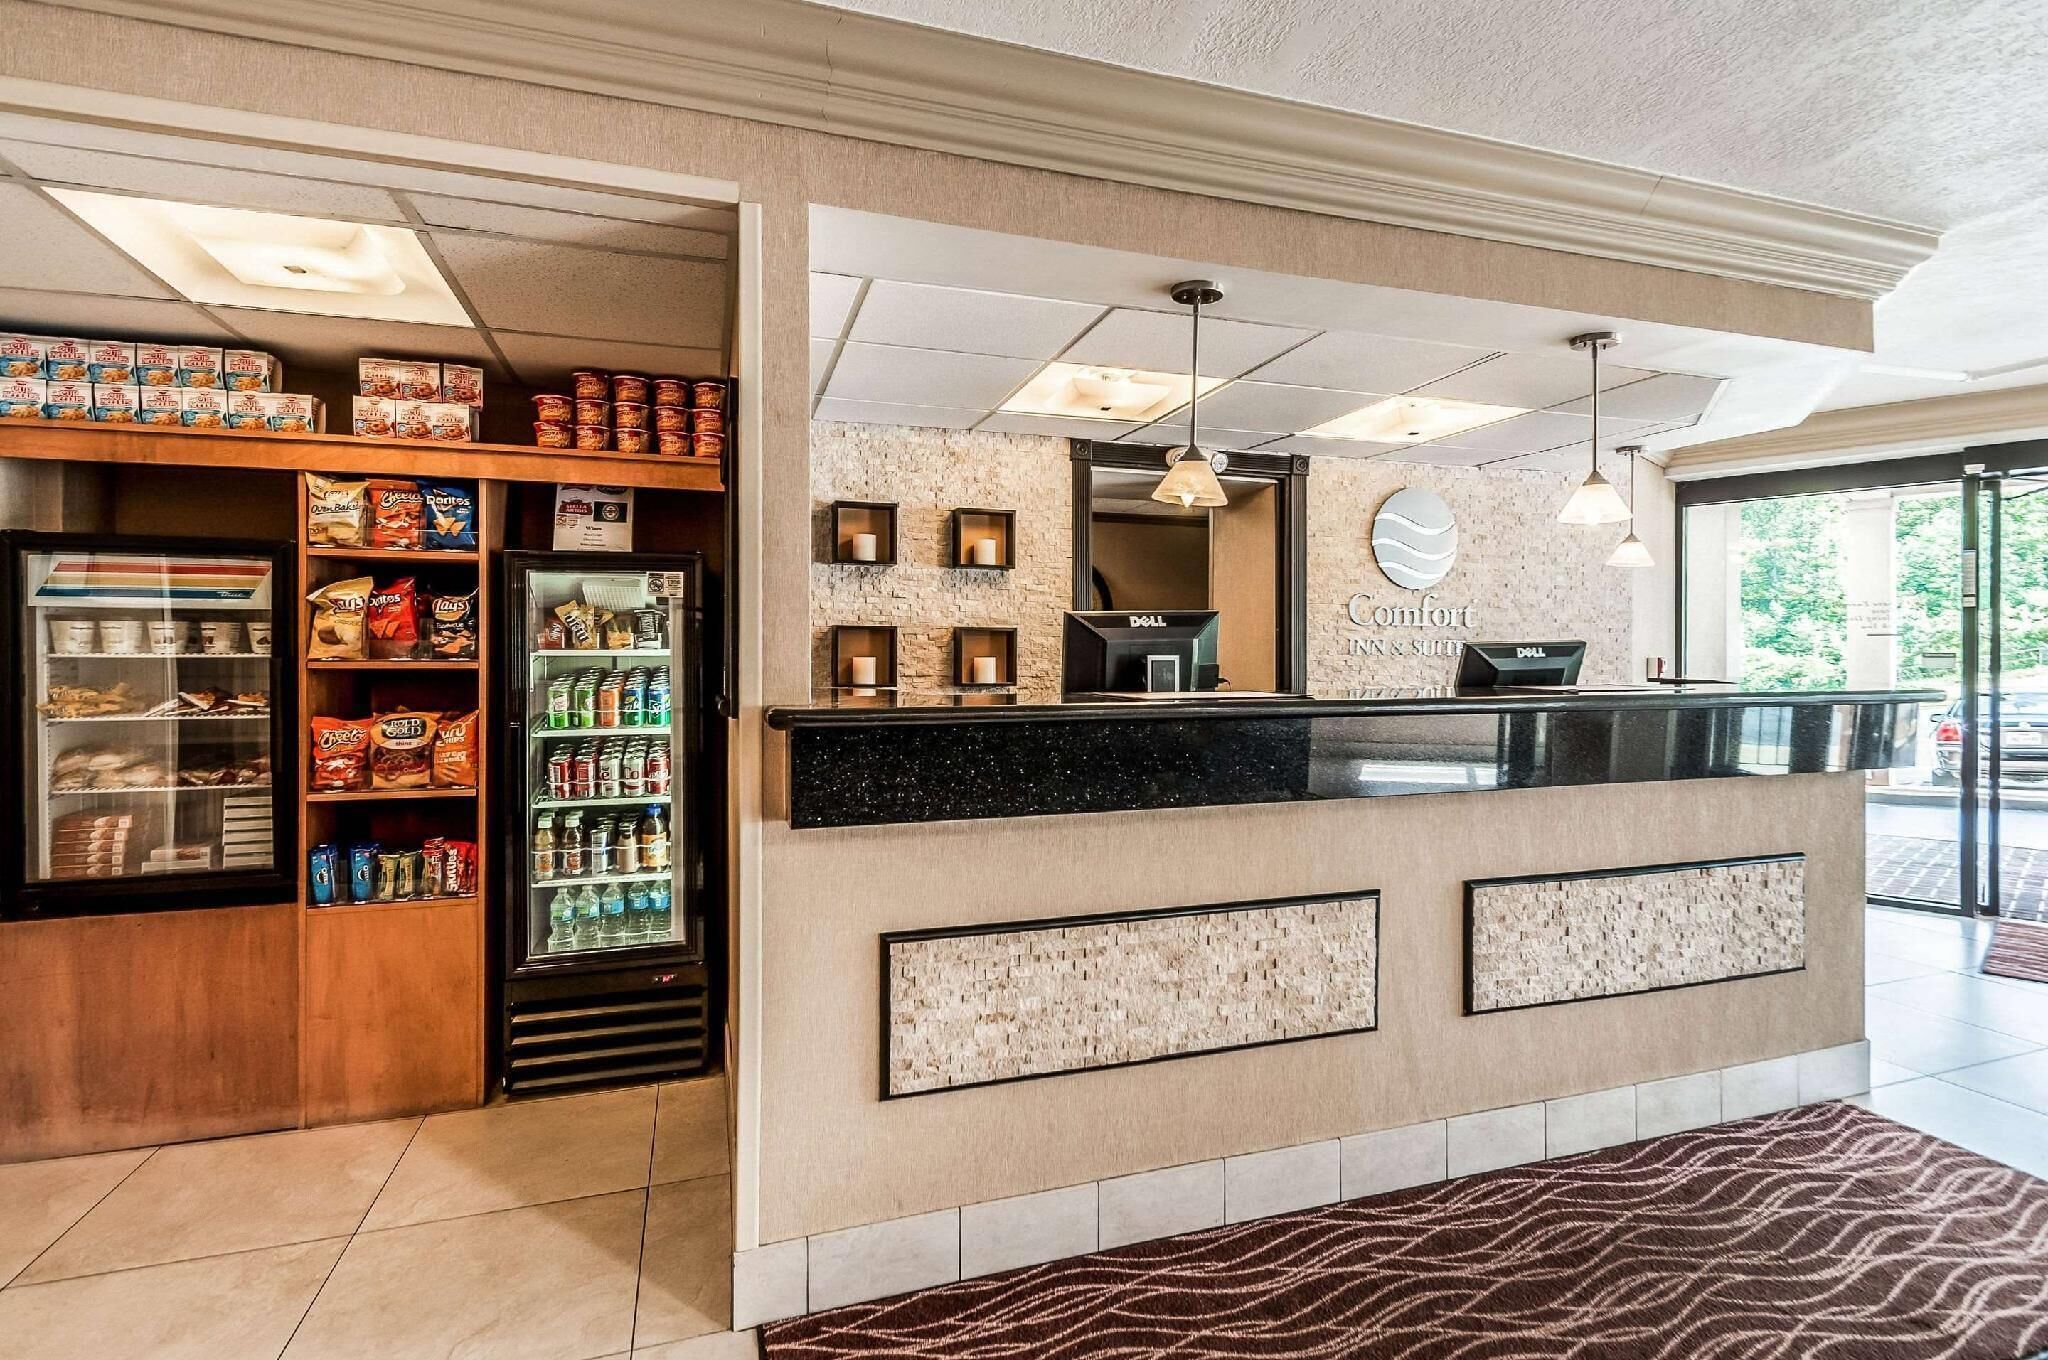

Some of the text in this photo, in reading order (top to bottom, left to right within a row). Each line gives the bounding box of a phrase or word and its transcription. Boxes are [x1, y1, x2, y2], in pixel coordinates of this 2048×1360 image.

[427, 496, 470, 505] Doritos
[1348, 593, 1480, 628] Comfort
[1129, 616, 1167, 628] DELL
[1348, 639, 1466, 657] INN & SUITE
[1517, 648, 1546, 658] DELL
[386, 727, 422, 737] GOLD
